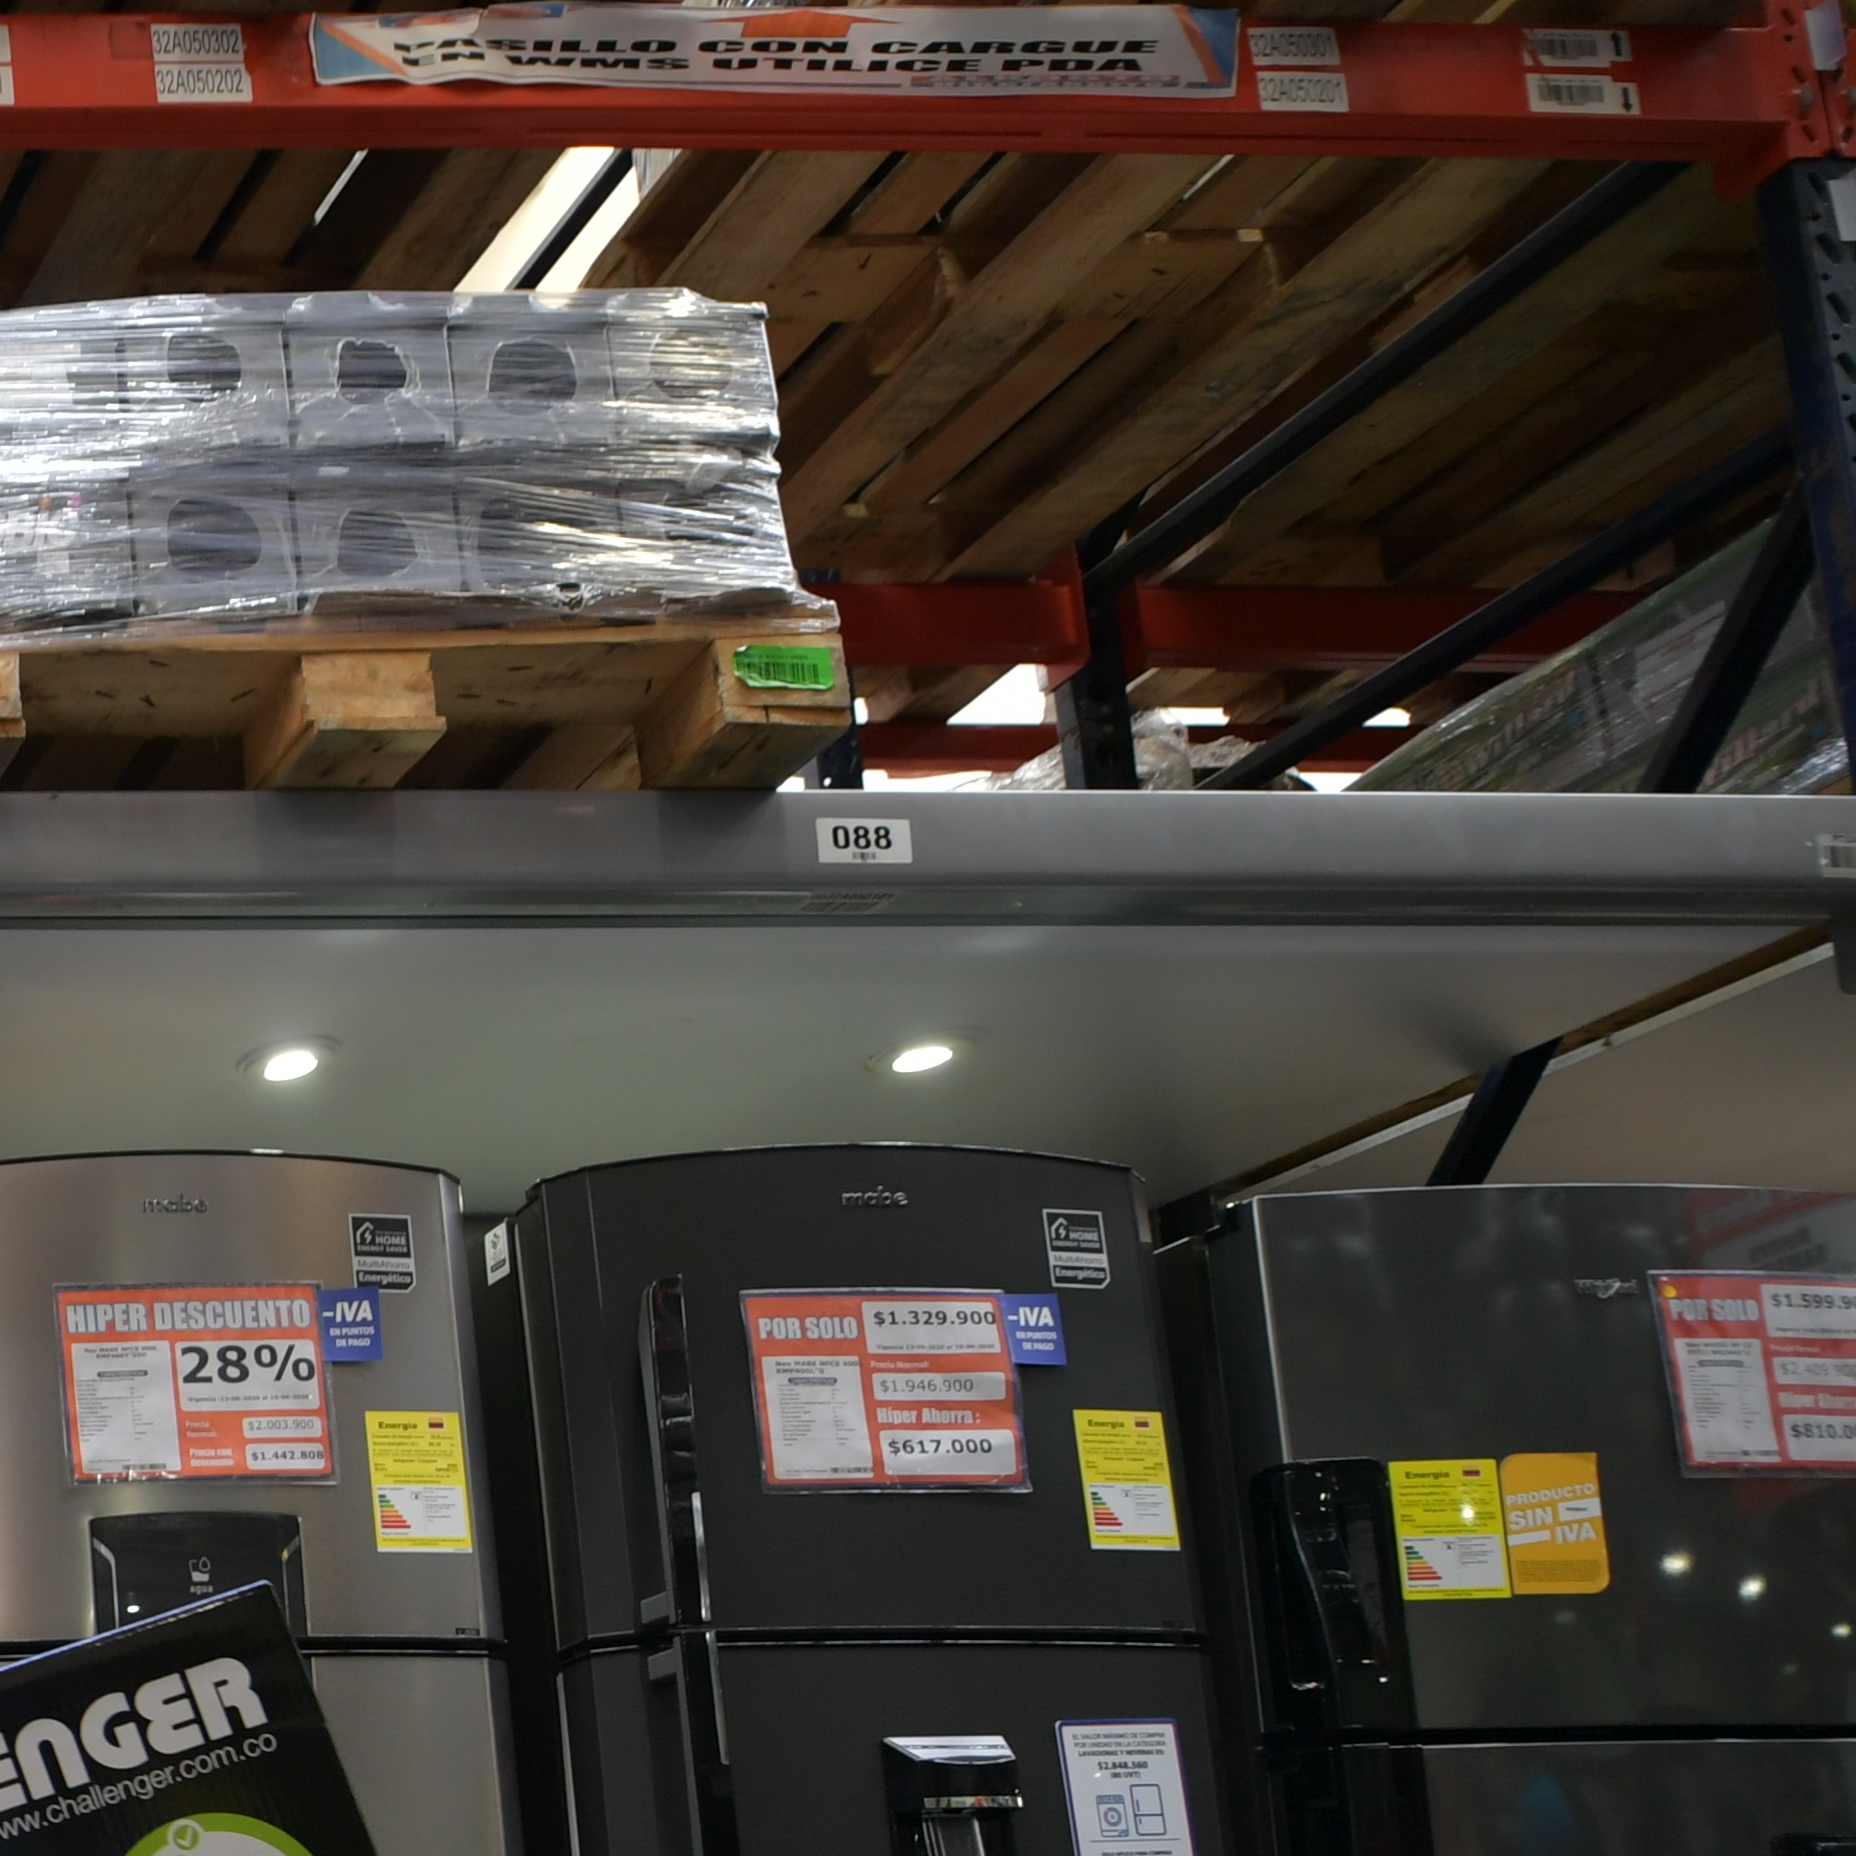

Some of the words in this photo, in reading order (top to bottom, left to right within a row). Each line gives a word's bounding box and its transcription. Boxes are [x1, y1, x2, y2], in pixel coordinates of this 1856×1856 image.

[152, 29, 240, 55] 32A050302
[698, 39, 848, 54] CON
[870, 39, 1160, 55] CARGUE
[505, 55, 690, 70] WMS
[712, 57, 983, 72] UTILICE
[1000, 58, 1144, 72] PDA
[155, 68, 244, 94] 32A050202
[831, 825, 893, 850] 088
[141, 1193, 208, 1215] mabe
[841, 1185, 909, 1207] mabe
[374, 1233, 407, 1246] HOME
[358, 1270, 412, 1287] Energético
[1054, 1266, 1106, 1282] Energético
[65, 1302, 148, 1335] HIPER
[153, 1297, 311, 1332] DESCUENTO
[321, 1300, 374, 1324] -IVA
[872, 1309, 997, 1327] $1.329.900
[1006, 1306, 1055, 1328] -IVA
[1668, 1298, 1708, 1321] POR
[1711, 1298, 1760, 1322] SOLO
[757, 1317, 803, 1342] POR
[805, 1316, 859, 1341] SOLO
[179, 1342, 316, 1385] 28%
[879, 1377, 975, 1395] $1.946.900
[247, 1418, 315, 1432] $2.003.900
[377, 1420, 419, 1432] Energía
[876, 1407, 918, 1426] Híper
[921, 1407, 974, 1424] Ahorra
[1087, 1418, 1125, 1431] Energía
[251, 1449, 325, 1462] $1.442.808
[887, 1437, 993, 1457] $617.000
[1404, 1469, 1451, 1481] Energía
[1506, 1483, 1595, 1506] PRODUCTO
[1509, 1506, 1553, 1531] SIN
[1555, 1522, 1597, 1545] IVA
[189, 1583, 214, 1595] agua
